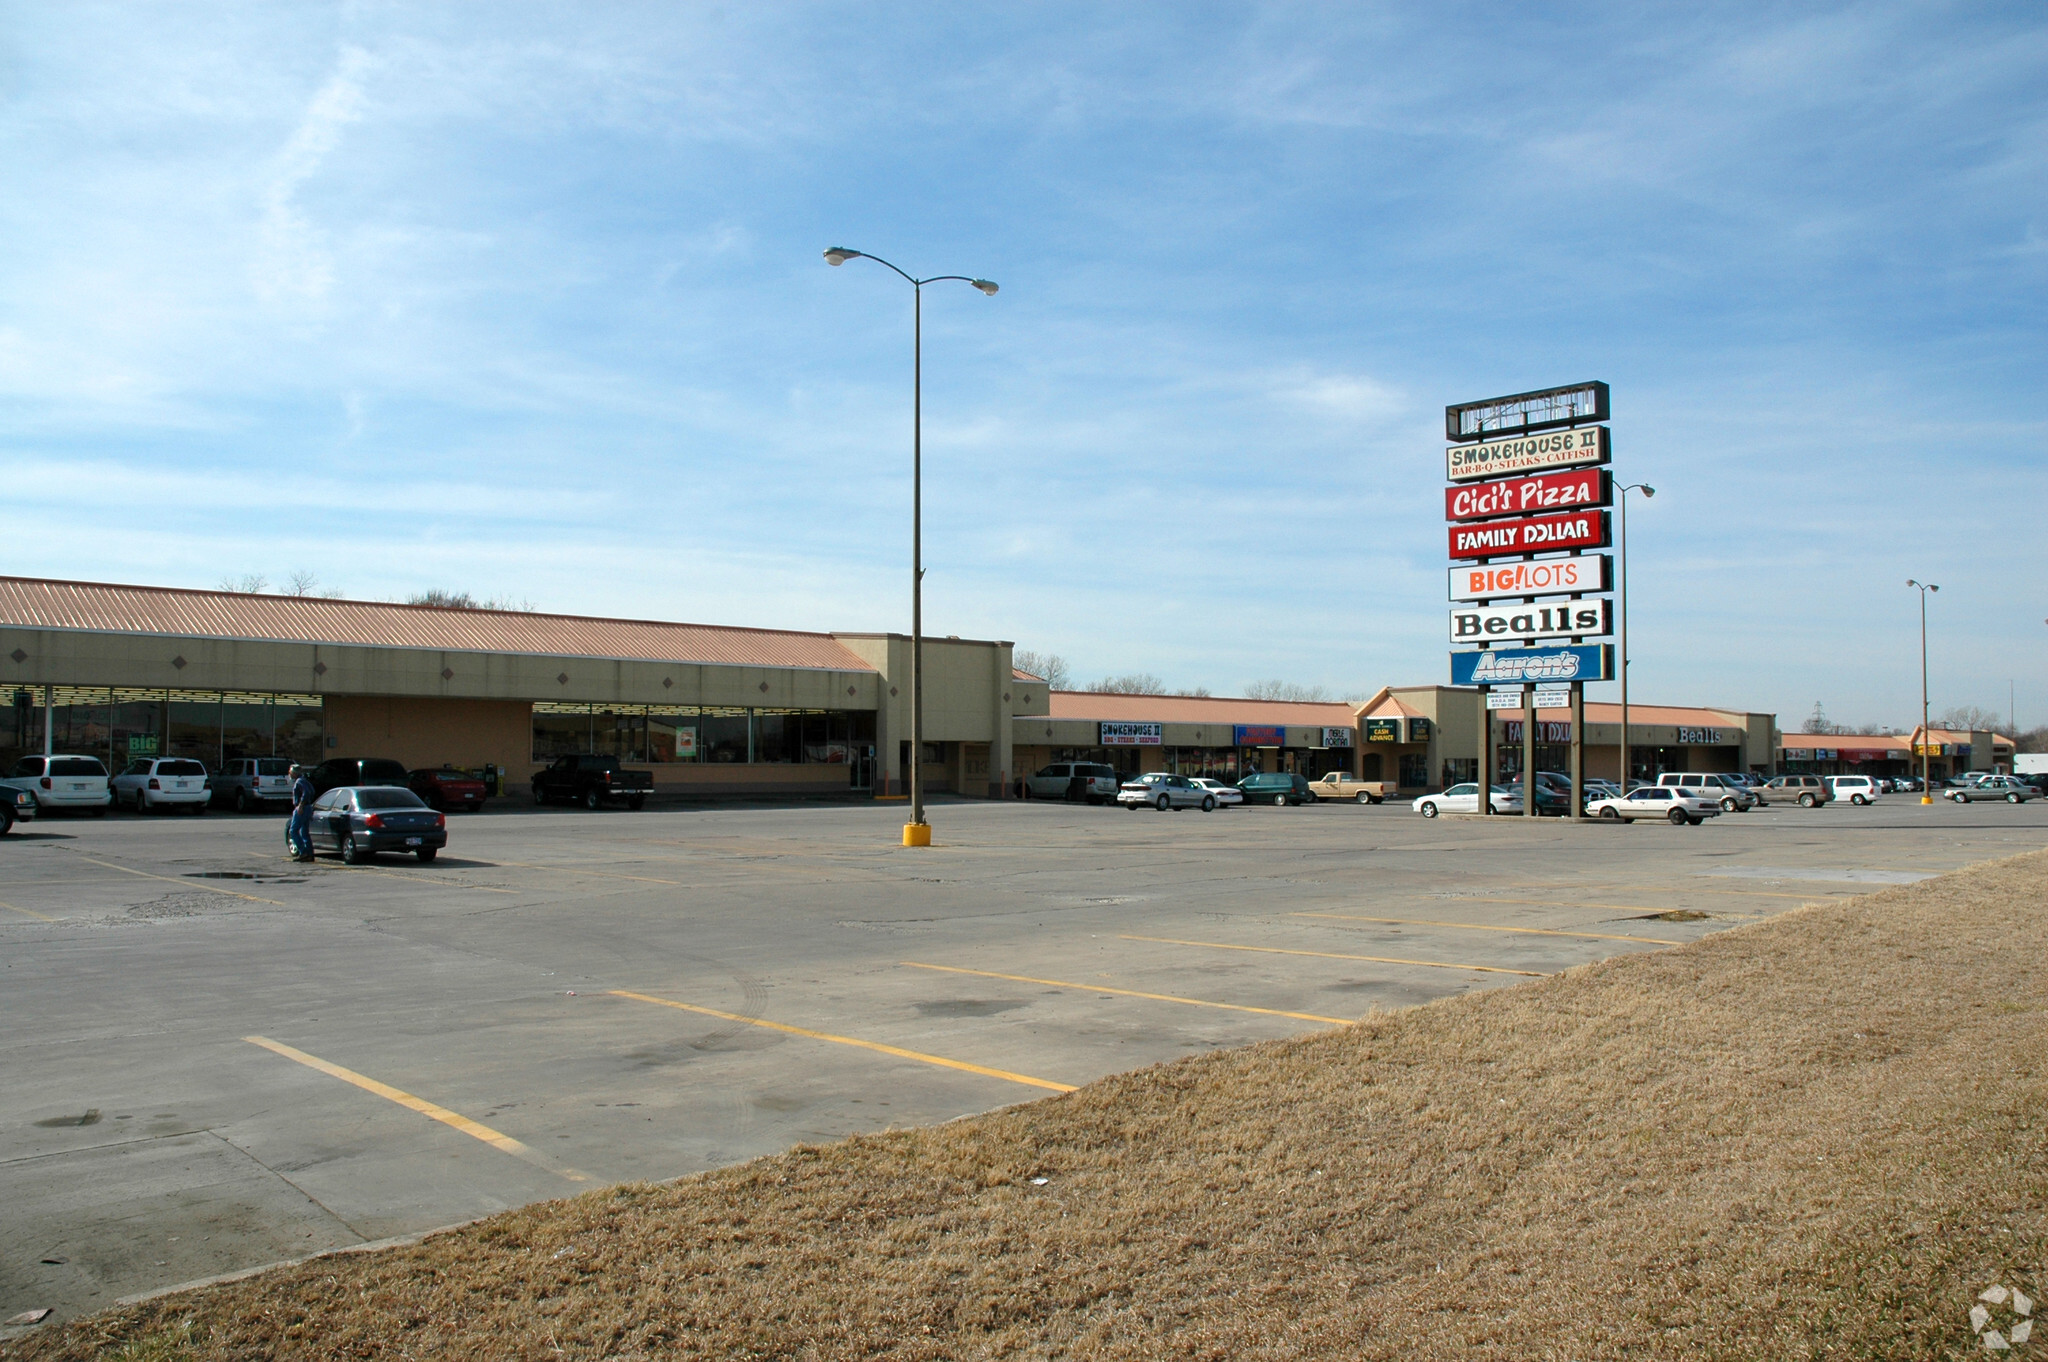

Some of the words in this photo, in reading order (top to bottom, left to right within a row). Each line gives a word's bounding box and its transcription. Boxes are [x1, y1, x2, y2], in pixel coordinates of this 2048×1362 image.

[1451, 434, 1574, 466] SMOKEHOUSE
[1580, 430, 1596, 448] II
[1546, 448, 1595, 463] CATFISH
[1453, 482, 1513, 516] Cici's
[1457, 527, 1518, 551] FAMILY
[1523, 519, 1589, 544] DOLLAR
[1454, 607, 1598, 637] Bealls
[1471, 651, 1580, 682] Aaron's
[129, 736, 157, 750] BIG
[1102, 724, 1152, 736] SMOKEHOUSE
[1154, 725, 1160, 736] II
[1679, 727, 1721, 743] Bealls
